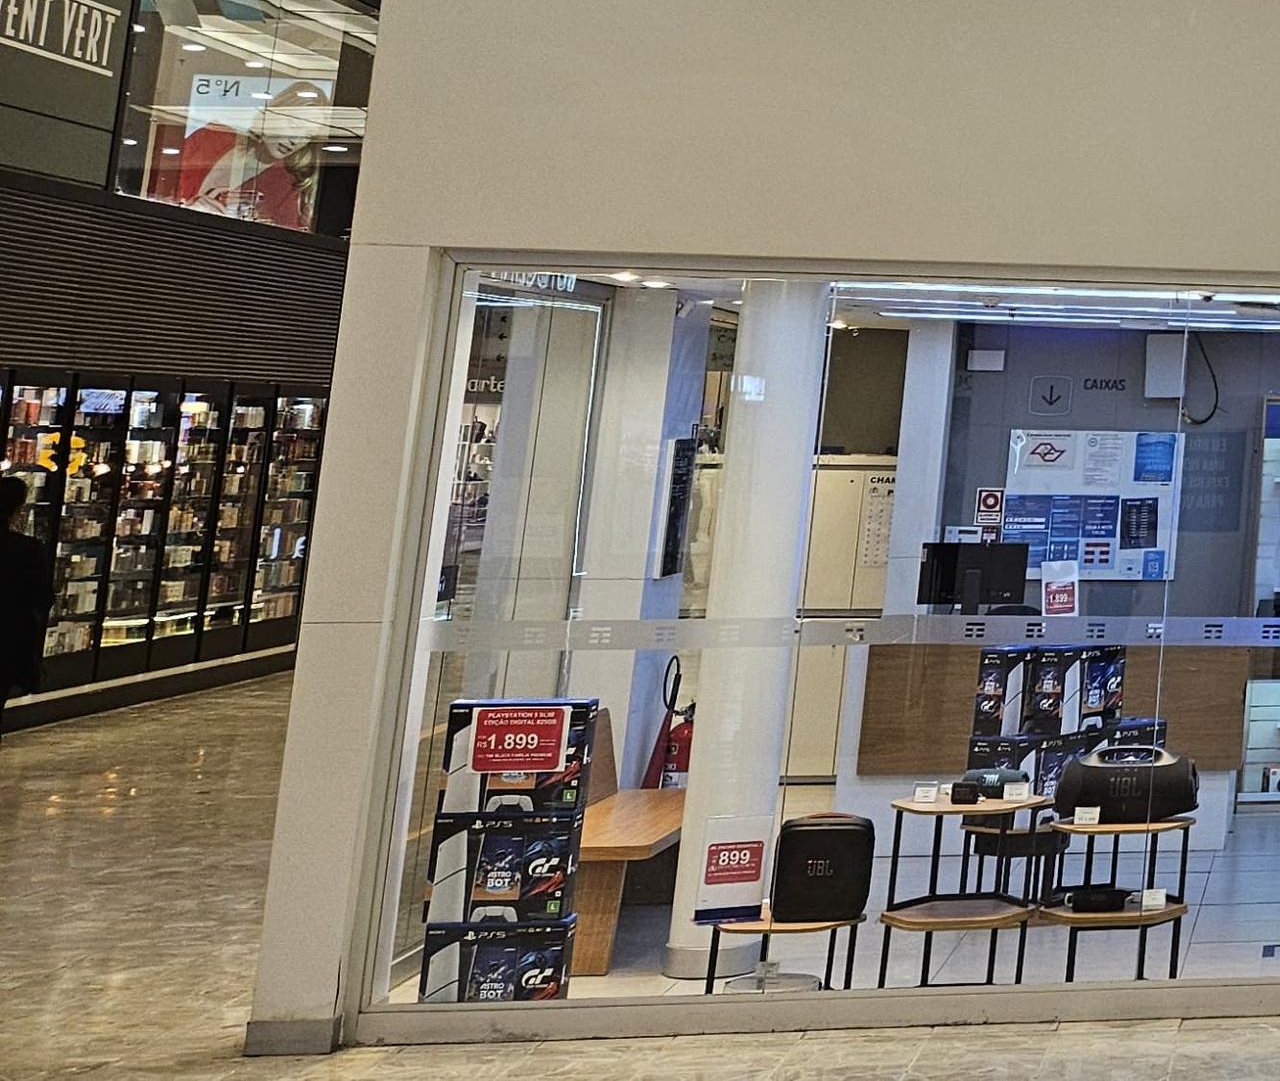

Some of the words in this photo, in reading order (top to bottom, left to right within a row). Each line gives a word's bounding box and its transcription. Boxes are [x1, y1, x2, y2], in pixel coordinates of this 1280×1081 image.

[64, 0, 116, 66] VERT
[1084, 378, 1126, 392] CAIXAS
[484, 718, 509, 726] EDIÇÃO
[510, 718, 534, 726] DIGITAL
[487, 733, 539, 750] 1.899
[983, 774, 1000, 787] JBL
[1110, 776, 1142, 798] JBL
[486, 820, 513, 828] PS5
[718, 850, 751, 866] 899
[807, 859, 833, 877] JBL
[487, 870, 512, 878] ASTRO
[486, 878, 512, 887] BOT
[478, 931, 507, 939] PS5
[480, 982, 505, 990] ASTRO
[480, 989, 503, 999] BOT
